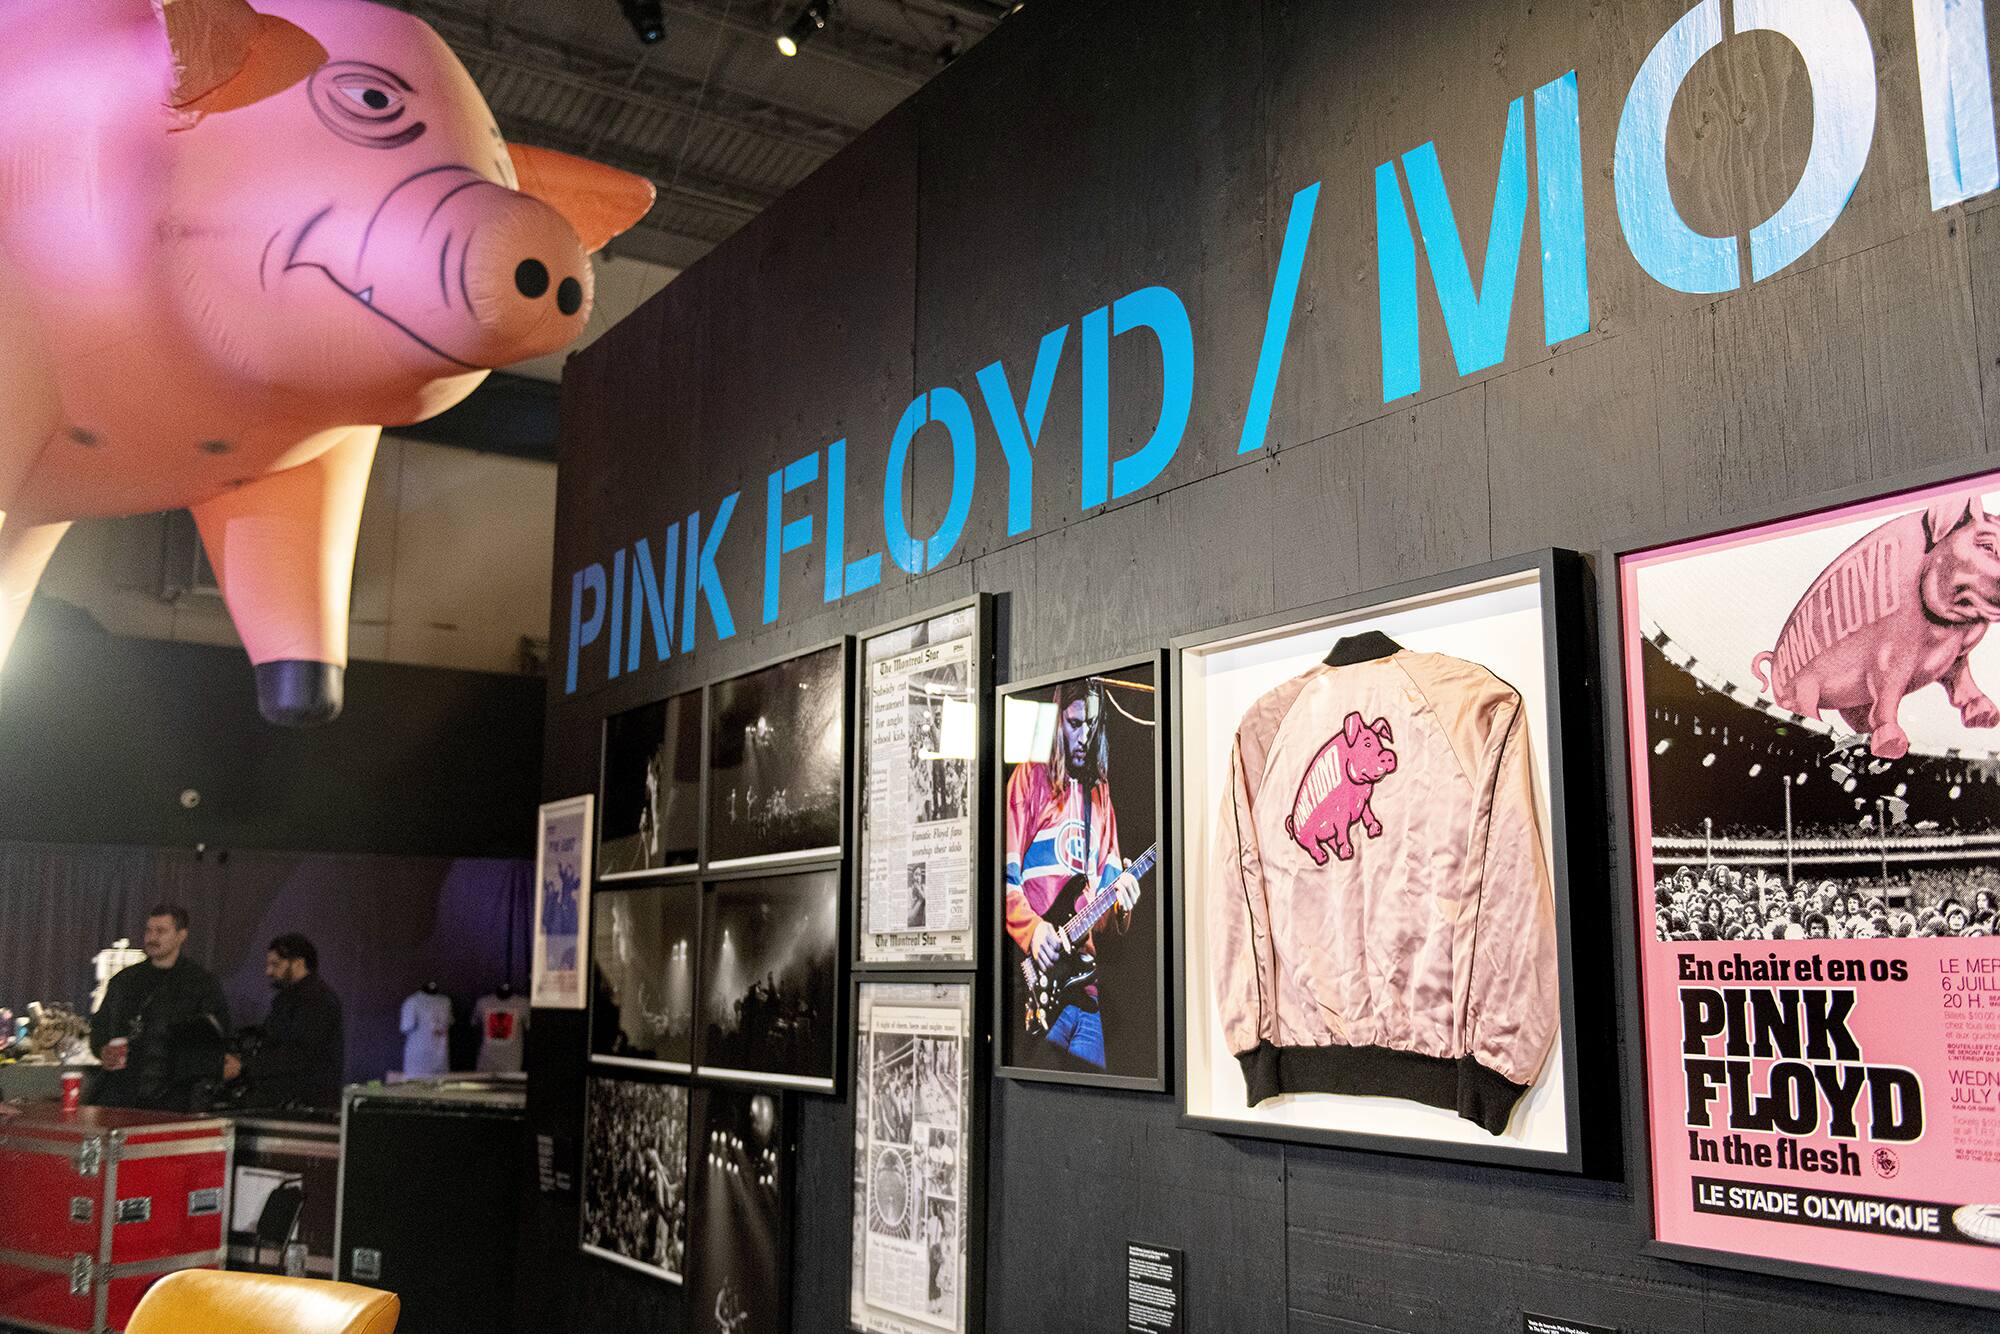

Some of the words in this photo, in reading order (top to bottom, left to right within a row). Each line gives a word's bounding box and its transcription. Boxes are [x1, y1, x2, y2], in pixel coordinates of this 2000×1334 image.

[564, 491, 741, 695] PINK
[763, 286, 1195, 625] FLOYD
[1237, 181, 1321, 455] /
[1777, 593, 1822, 698] PINK
[1819, 537, 1901, 648] FLOYD
[880, 662, 892, 675] The
[893, 653, 924, 673] Montreal
[925, 649, 939, 663] Star
[874, 934, 888, 948] The
[889, 932, 921, 948] Montreal
[922, 932, 937, 947] Star
[1677, 953, 1714, 981] En
[1717, 953, 1791, 981] chair
[1795, 954, 1824, 982] et
[1827, 959, 1867, 982] en
[1870, 959, 1909, 982] os
[1940, 958, 1960, 974] LE
[1942, 976, 1952, 991] 6
[1943, 993, 1962, 1008] 20
[1968, 994, 1985, 1008] H.
[1678, 986, 1863, 1063] PINK
[1948, 1070, 2000, 1087] WEDN
[1683, 1057, 1926, 1144] FLOYD
[1951, 1088, 1991, 1104] JULY
[1688, 1130, 1719, 1163] In
[1723, 1133, 1772, 1168] the
[1777, 1137, 1862, 1177] flesh
[1699, 1183, 1725, 1207] LE
[1729, 1186, 1799, 1217] STADE
[1803, 1195, 1941, 1234] OLYMPIQUE
